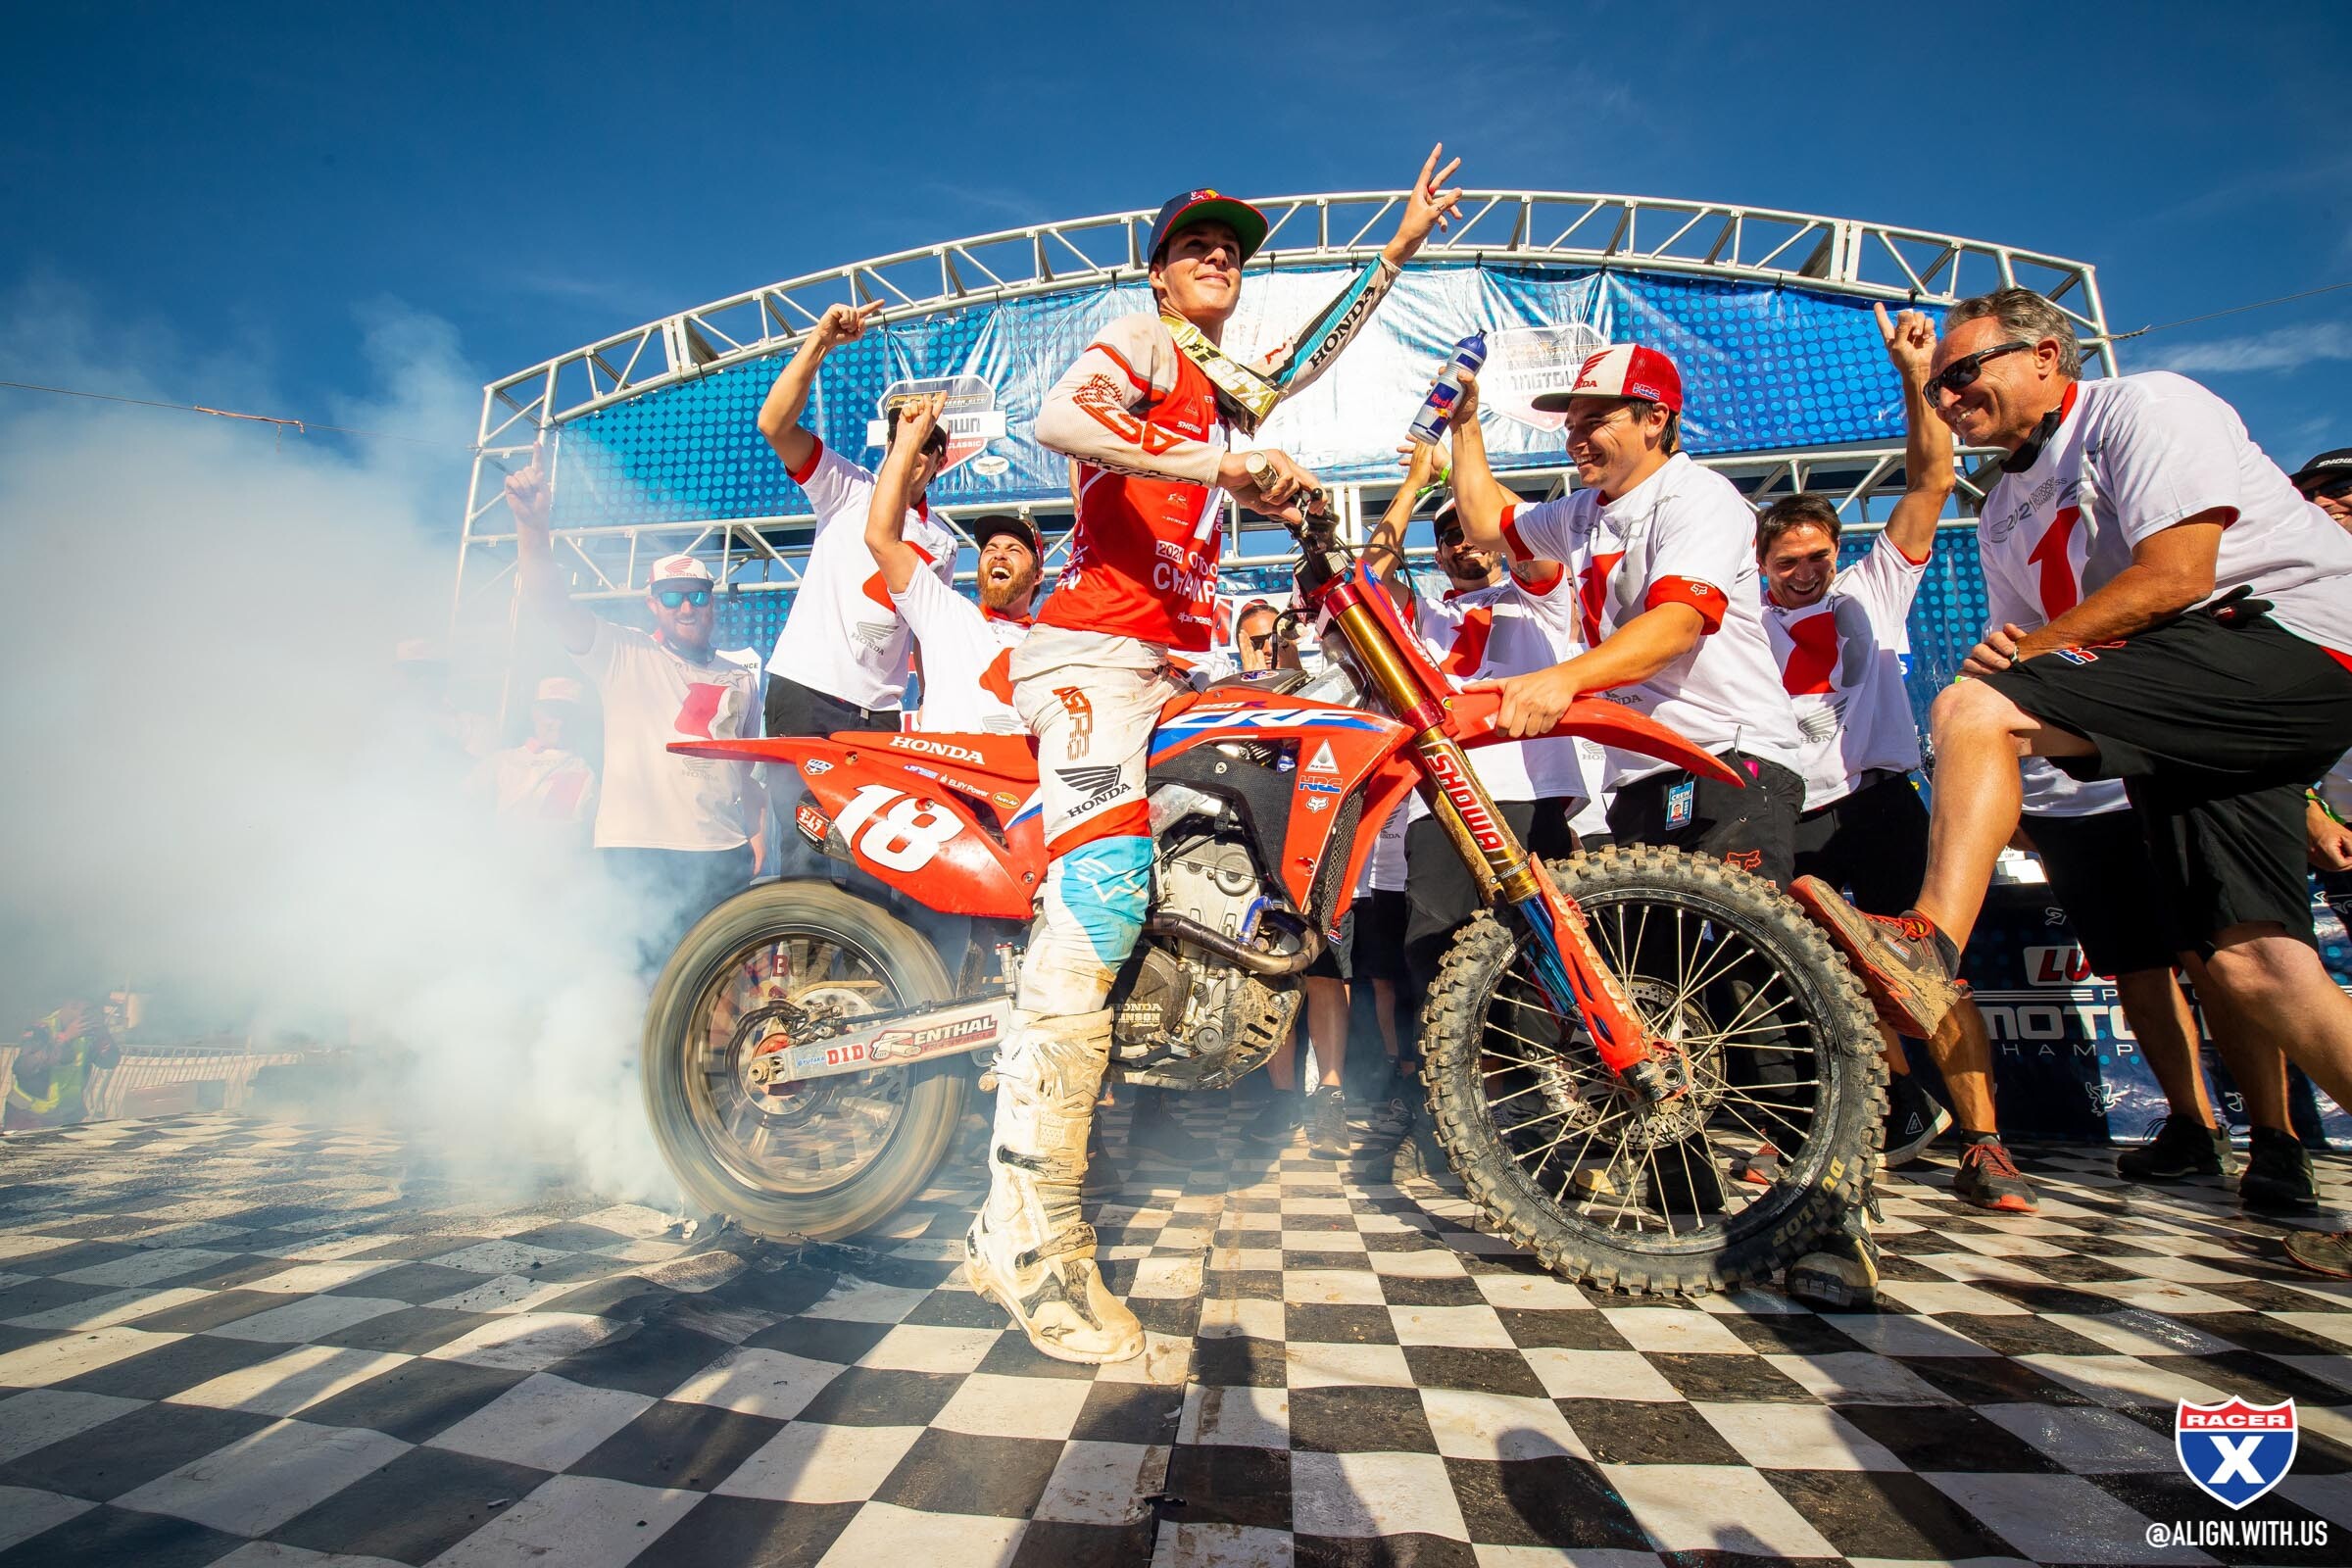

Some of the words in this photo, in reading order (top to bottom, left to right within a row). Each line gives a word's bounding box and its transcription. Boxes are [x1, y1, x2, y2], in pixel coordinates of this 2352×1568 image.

[1308, 285, 1377, 369] HONDA
[1632, 383, 1660, 401] HRC
[1177, 420, 1201, 434] SHOWA
[1157, 541, 1184, 563] 2021
[888, 735, 986, 765] HONDA
[1298, 775, 1343, 794] HRC
[1066, 784, 1132, 818] HONDA
[1425, 751, 1507, 854] SHOWA
[833, 784, 964, 873] 18
